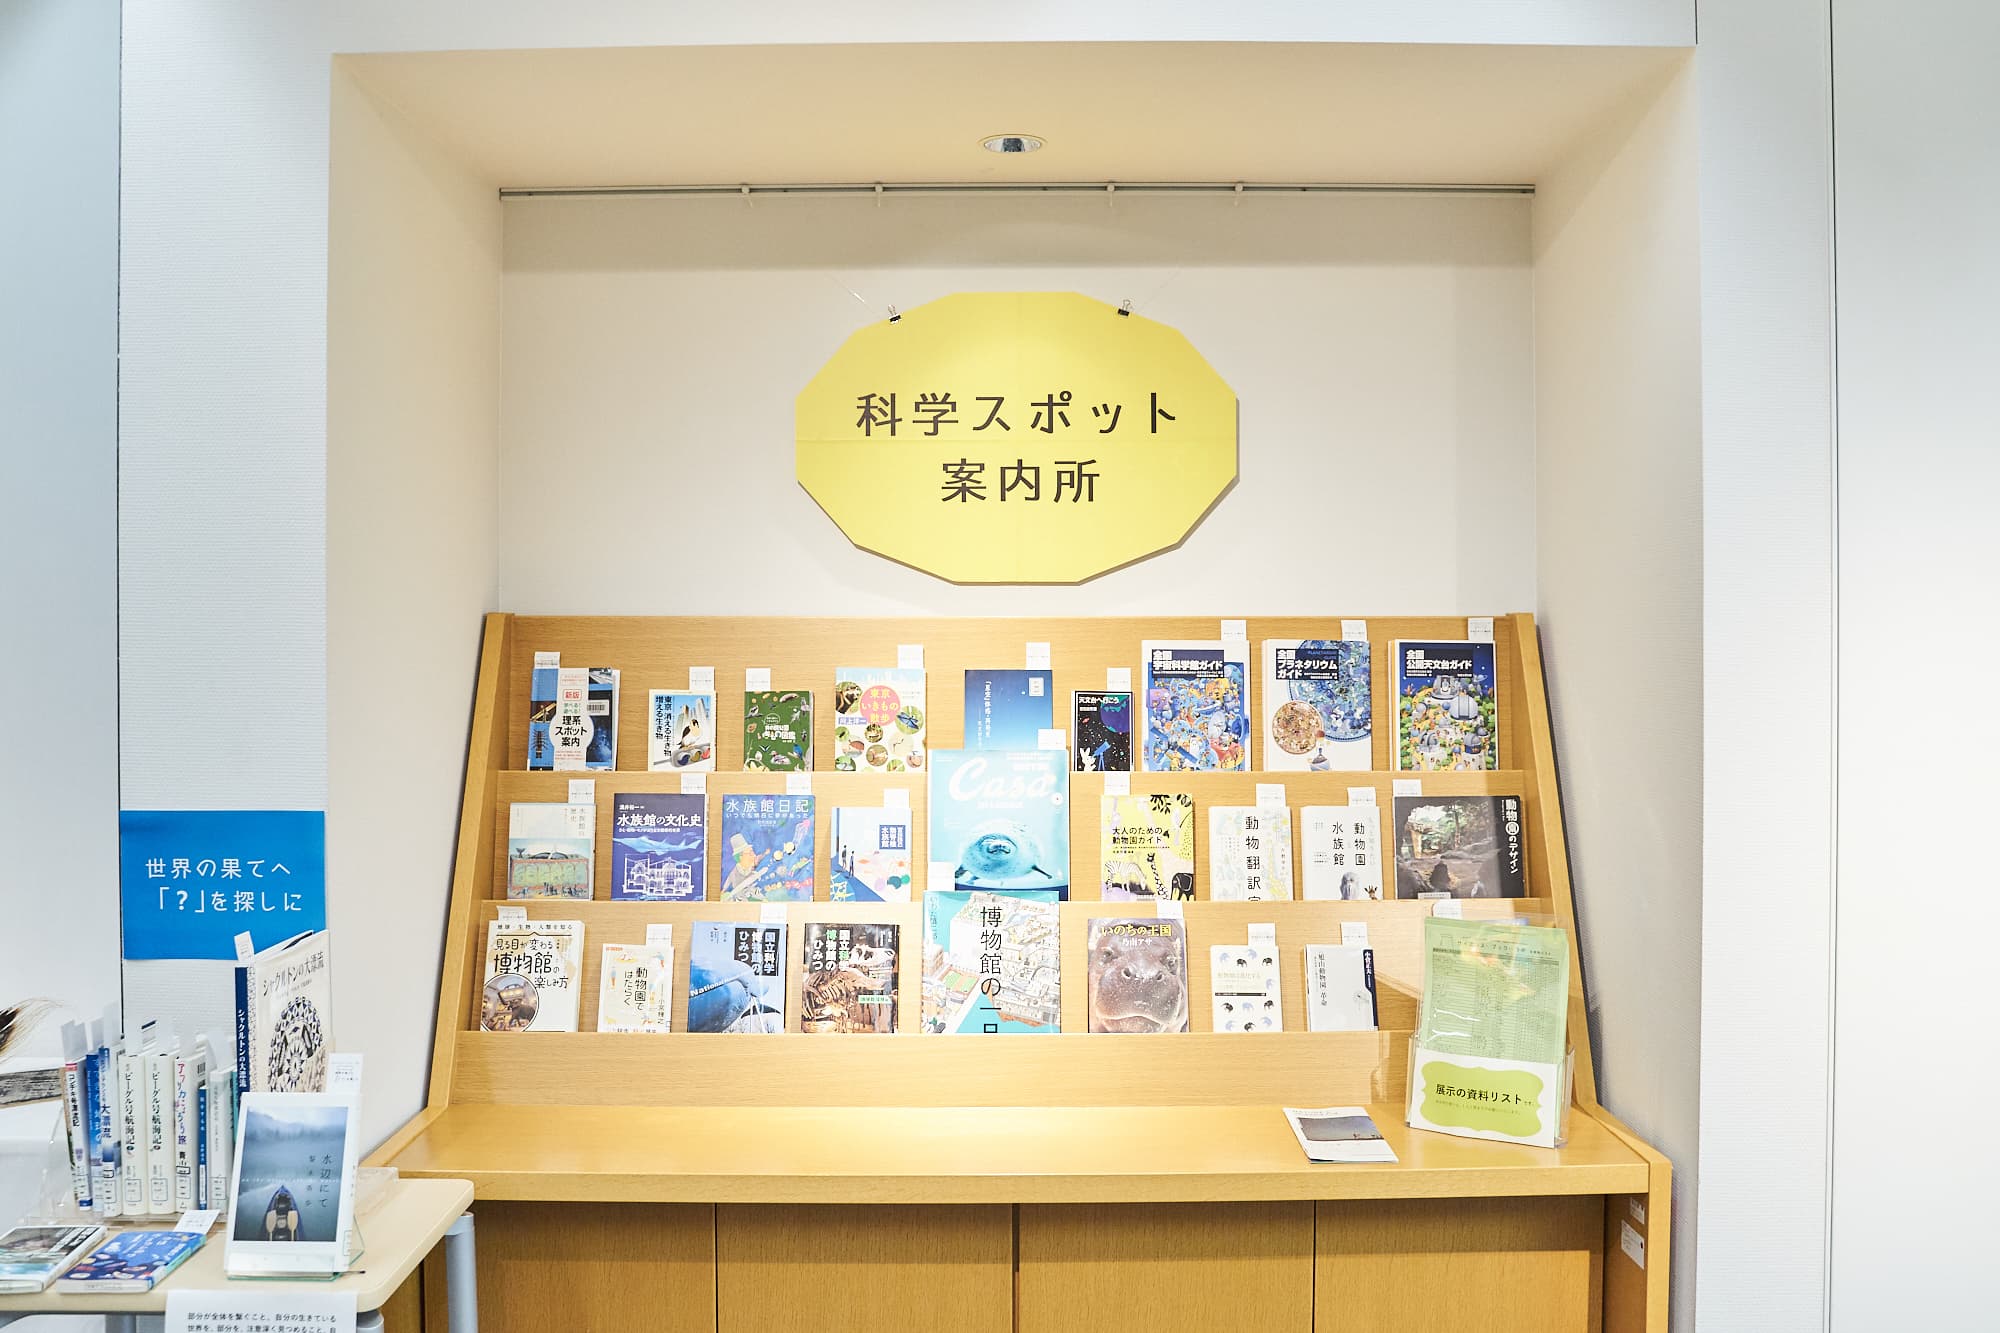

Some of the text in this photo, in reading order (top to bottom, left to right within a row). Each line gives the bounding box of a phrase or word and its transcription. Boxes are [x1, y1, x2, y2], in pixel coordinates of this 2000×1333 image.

[856, 390, 1177, 437] 科学スポット
[941, 457, 1100, 504] 案内所
[1277, 659, 1337, 670] プラネタリウム
[1277, 669, 1302, 679] ガイド
[861, 701, 899, 711] いきもの
[555, 726, 587, 736] スポット
[562, 715, 581, 726] 理系
[561, 737, 580, 747] 案内
[948, 756, 1057, 801] Casa
[726, 799, 809, 813] 水族館日記
[617, 813, 702, 827] 水族館の文化史
[1112, 826, 1163, 835] 大人のための
[1332, 821, 1345, 866] 水族館
[1354, 822, 1366, 866] 動物園
[1505, 799, 1520, 874] 動物園のデザイン
[145, 857, 291, 880] 世界の果てへ
[159, 886, 302, 913] 「?」を探しに
[1101, 923, 1173, 937] いのちの王国
[495, 938, 553, 951] 見る目が変わる
[738, 930, 749, 962] ひみつ
[763, 931, 776, 974] 国立科学
[812, 939, 824, 971] ひみつ
[494, 951, 560, 974] 博物館の
[535, 976, 569, 989] 楽しみ方
[624, 970, 633, 1006] はたらく
[1435, 1083, 1522, 1105] 展示の資料リスト
[319, 1154, 335, 1208] 水辺にて
